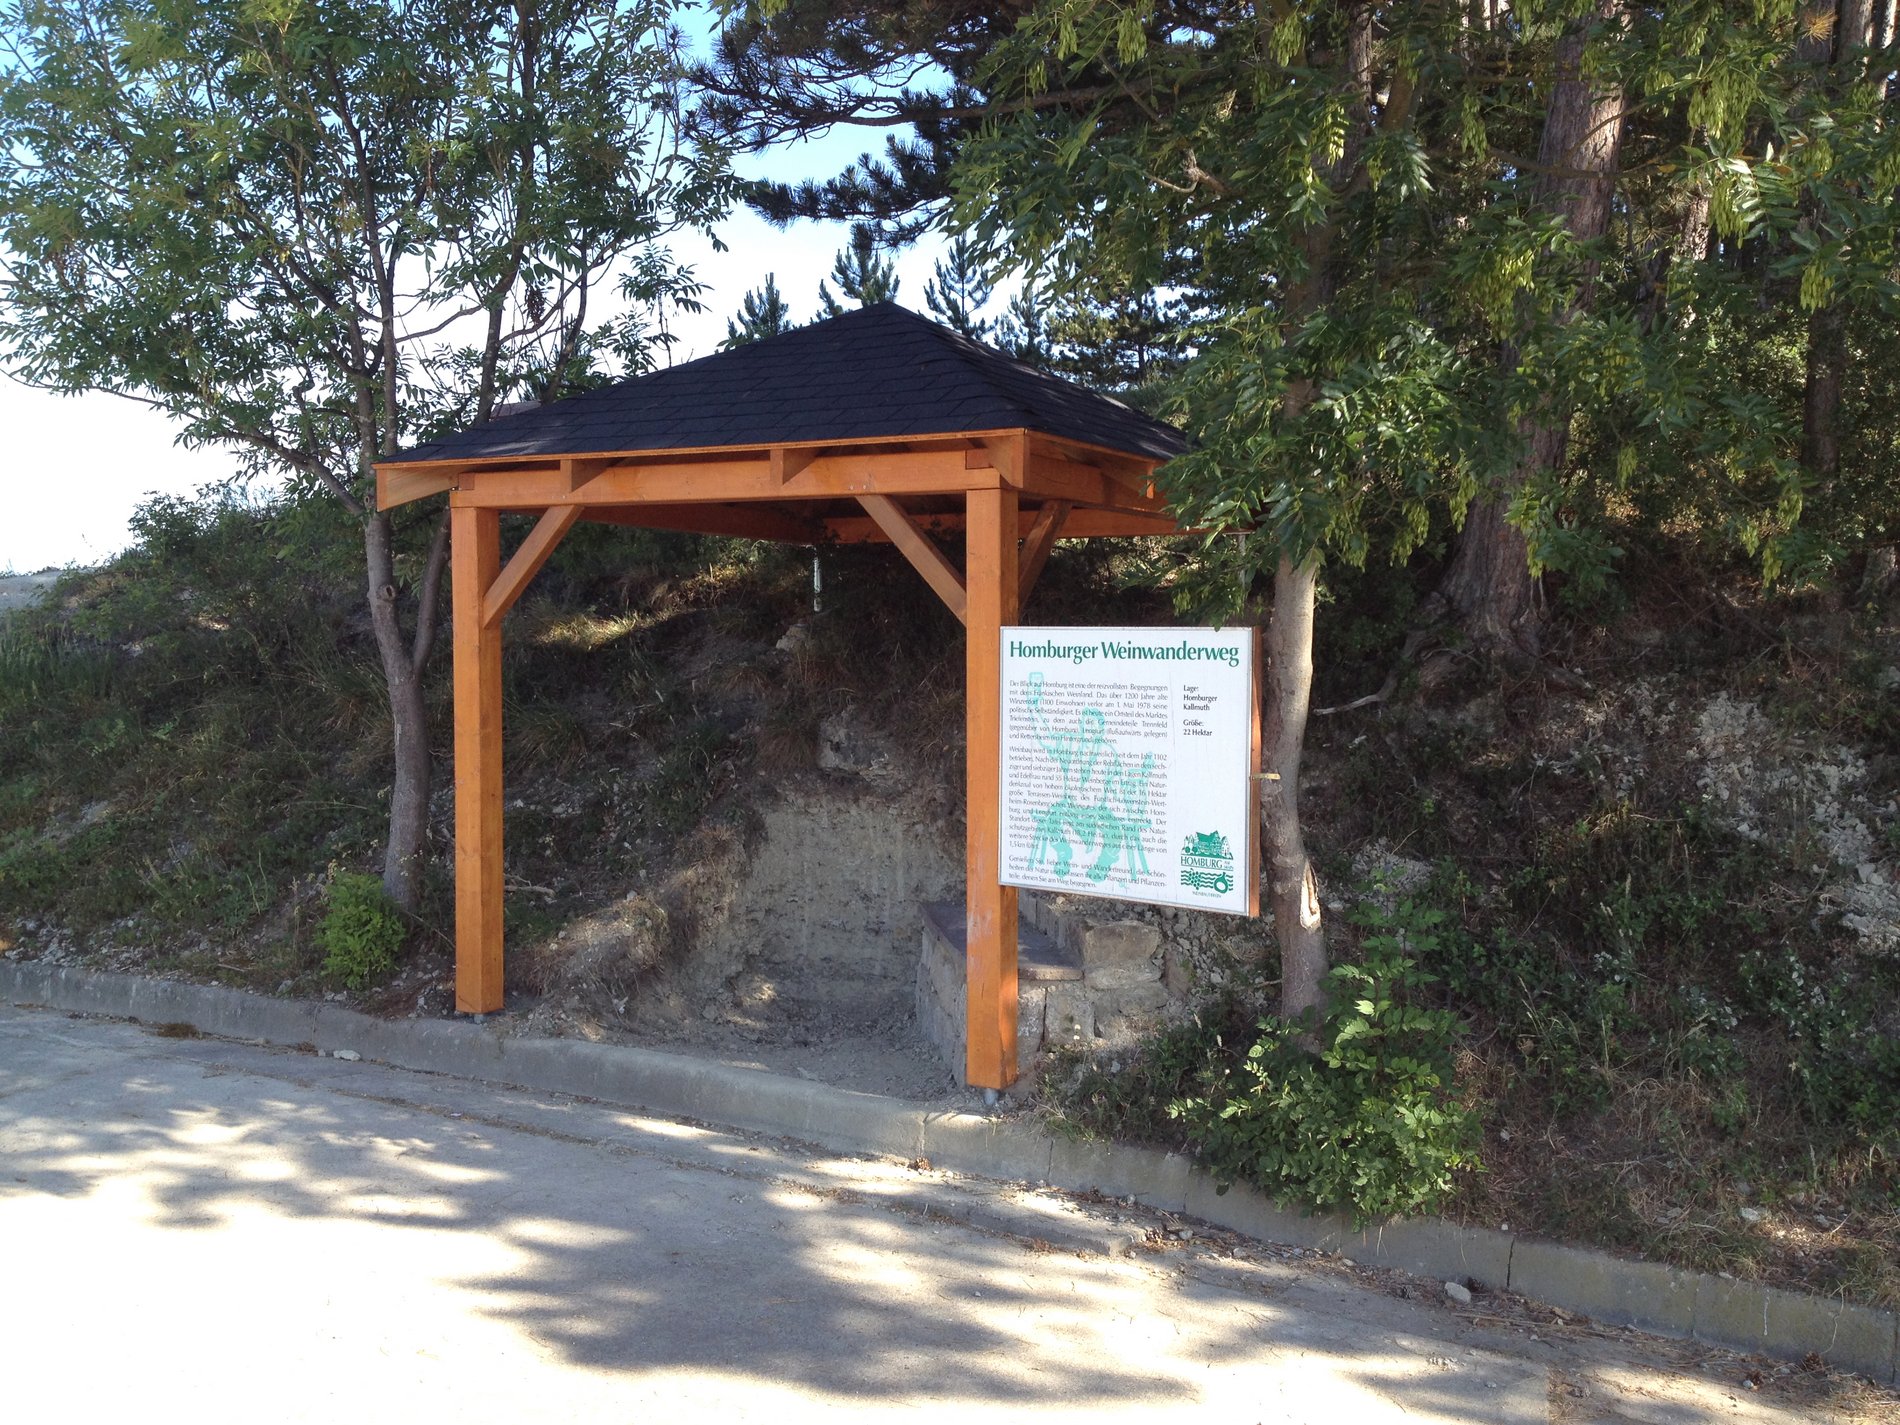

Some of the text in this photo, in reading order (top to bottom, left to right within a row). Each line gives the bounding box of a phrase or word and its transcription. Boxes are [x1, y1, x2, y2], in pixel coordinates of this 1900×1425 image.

[1010, 640, 1240, 667] Homburger Weinwanderweg
[1042, 681, 1067, 689] Homburg
[1129, 683, 1168, 692] Begegnungen
[1183, 684, 1199, 693] Lage:
[1183, 694, 1218, 703] Homburger
[1183, 703, 1210, 711] Kallmuth
[1180, 856, 1223, 869] HOMBURG
